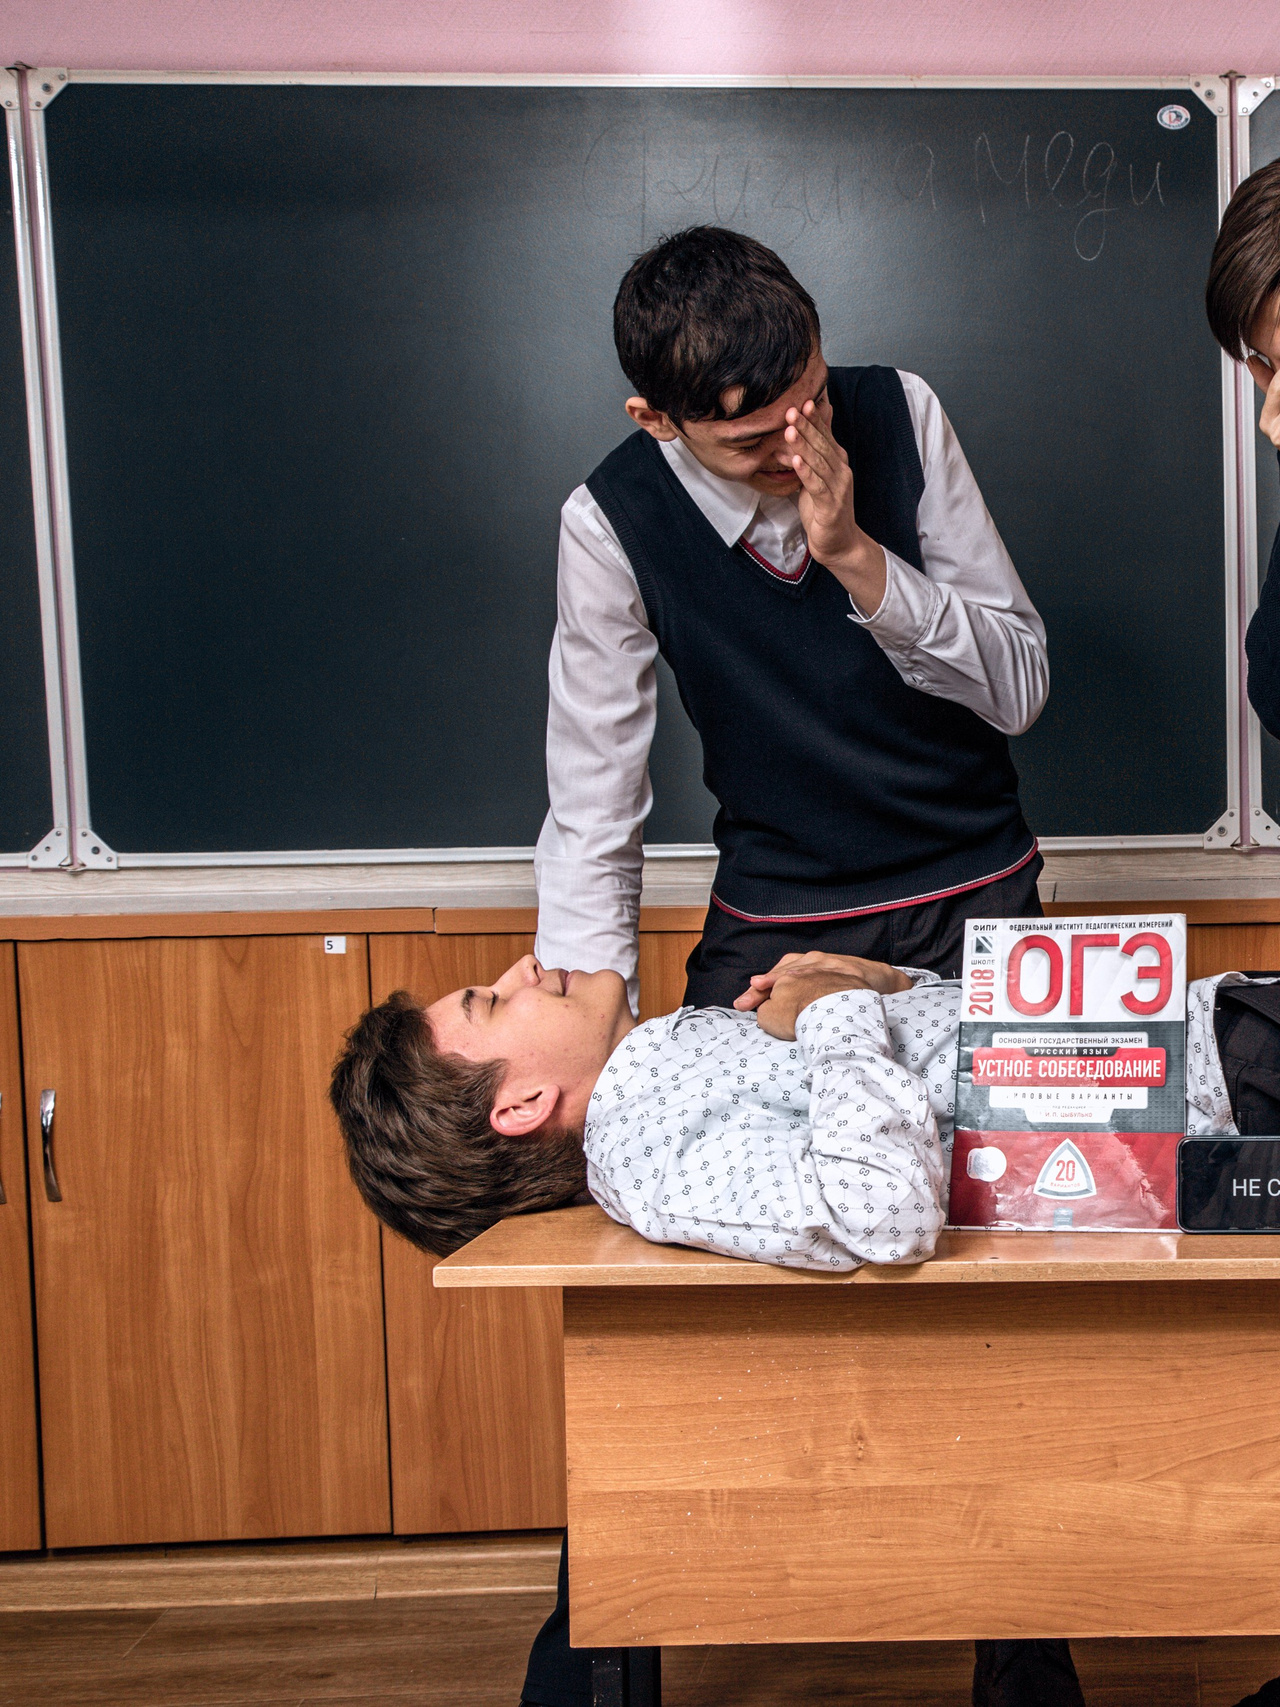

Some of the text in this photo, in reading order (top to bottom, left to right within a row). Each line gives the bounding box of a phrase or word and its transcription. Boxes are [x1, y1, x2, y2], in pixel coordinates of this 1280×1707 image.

[1009, 922, 1052, 932] ФЕДЕРАЛЬНЫЙ
[1086, 922, 1136, 930] ПЕДАГОГИЧЕСКИХ
[1139, 920, 1172, 928] ИЗМЕРЕНИЙ
[326, 940, 333, 950] 5
[1007, 932, 1173, 1016] ОГЭ
[969, 969, 994, 1016] 2018
[999, 1036, 1037, 1044] ОСНОВНОЙ
[1040, 1036, 1108, 1045] ГОСУДАРСТВЕННЫЙ
[1034, 1048, 1077, 1056] РУССКИЙ
[978, 1060, 1161, 1080] УСТНОЕ СОБЕСЕДОВАНИЕ
[1056, 1160, 1076, 1181] 20
[1232, 1178, 1261, 1196] НЕ
